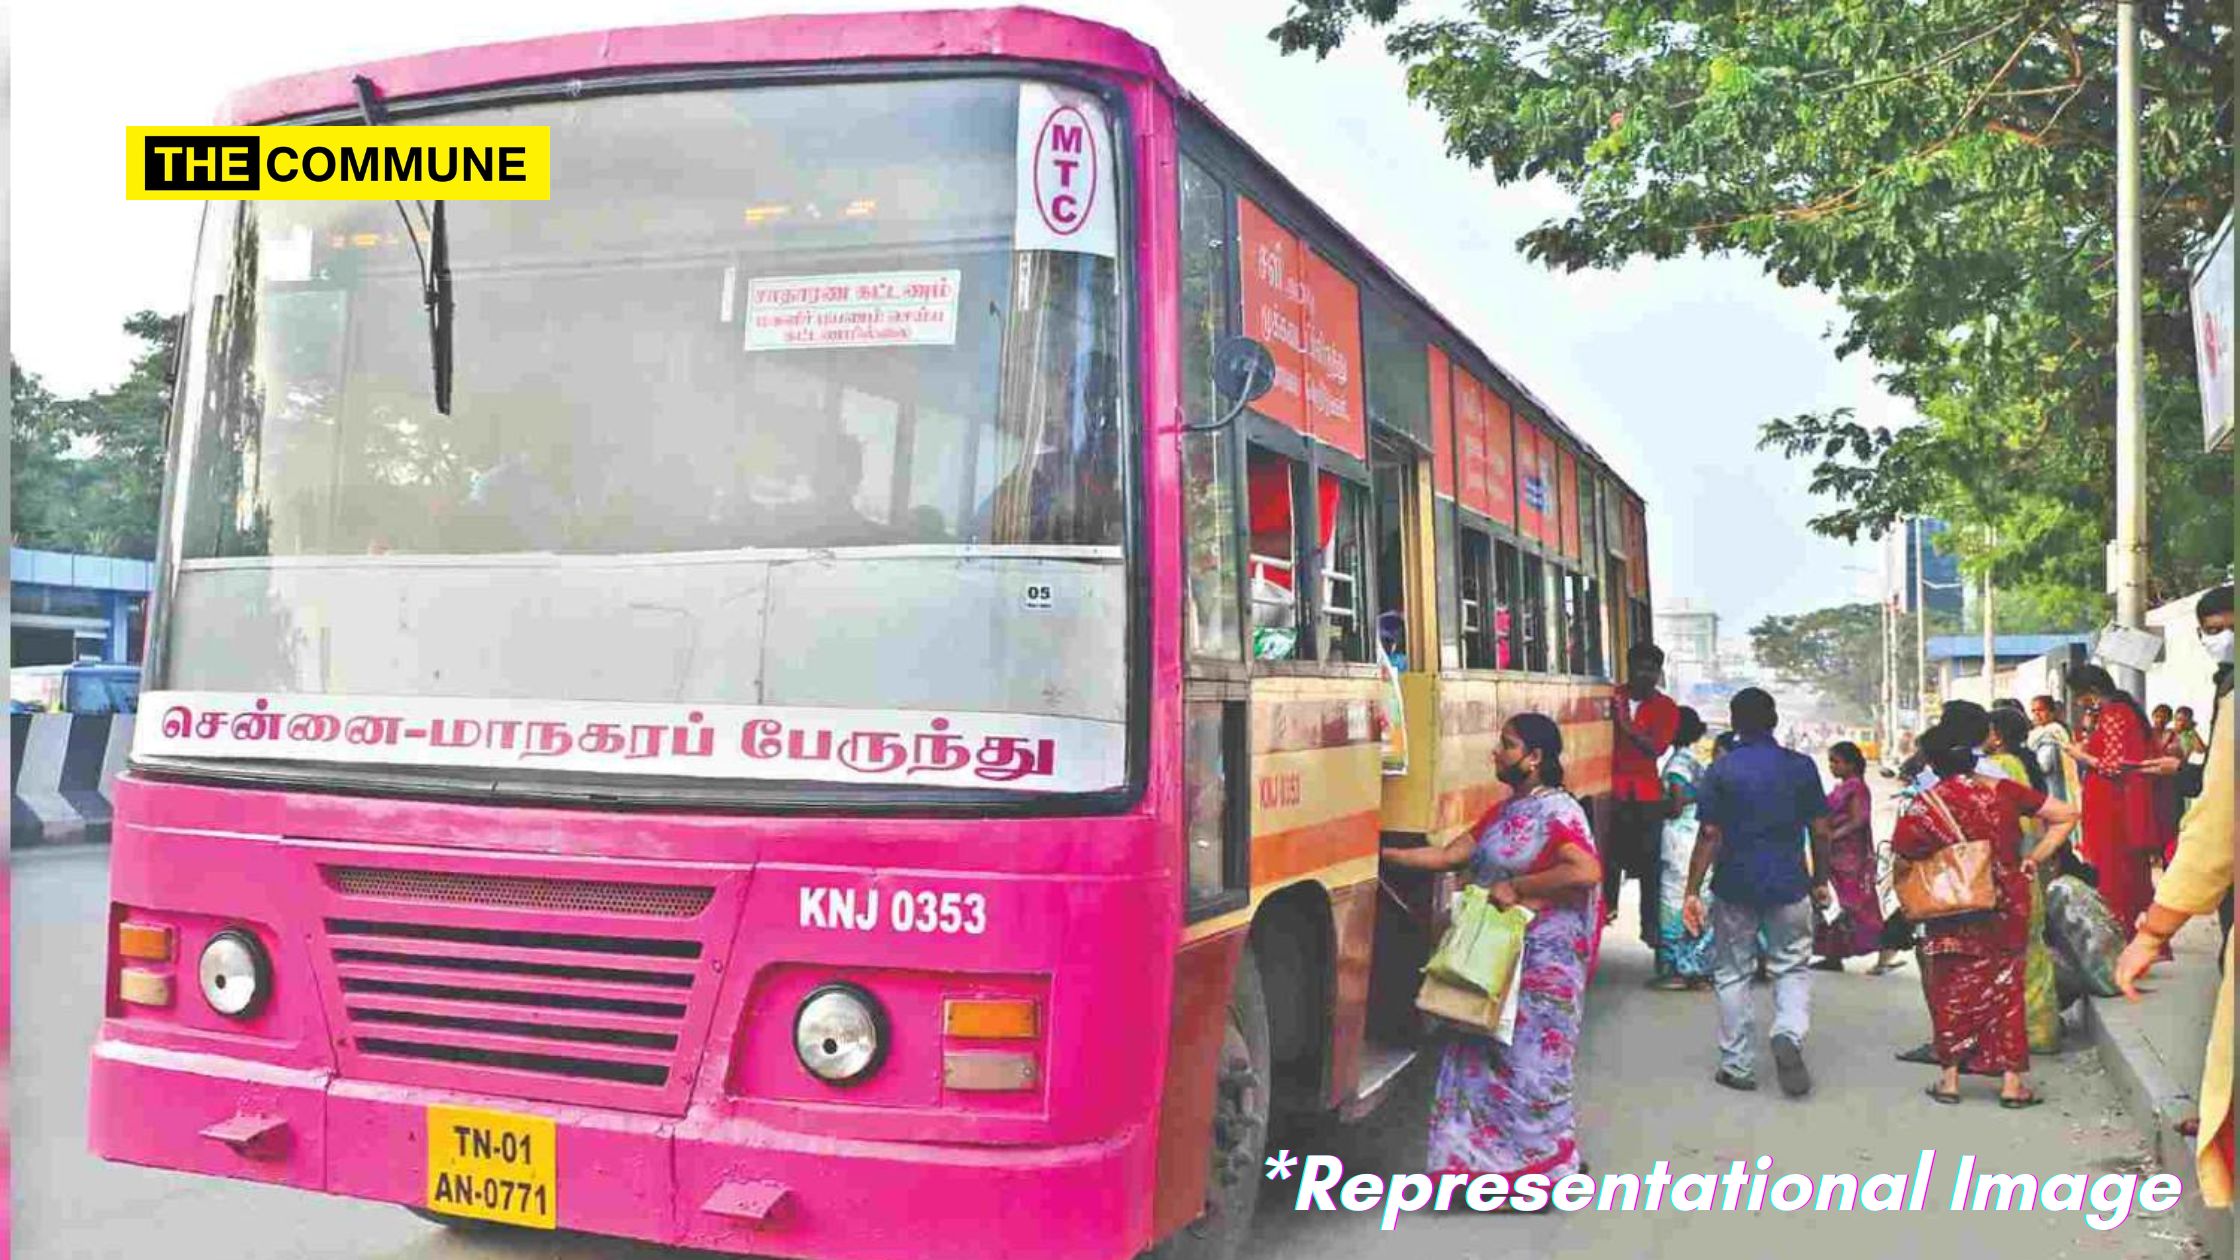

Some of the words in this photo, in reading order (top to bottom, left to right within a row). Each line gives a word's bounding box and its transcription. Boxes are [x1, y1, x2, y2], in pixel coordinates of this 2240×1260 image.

[1052, 124, 1083, 223] MTC
[162, 698, 715, 760] சென்னை-மாநகரப்
[740, 717, 1057, 782] பேருந்து
[800, 886, 879, 931] KNJ
[890, 889, 987, 935] 0353
[453, 1125, 531, 1165] TN-01
[434, 1172, 547, 1216] AN-0771
